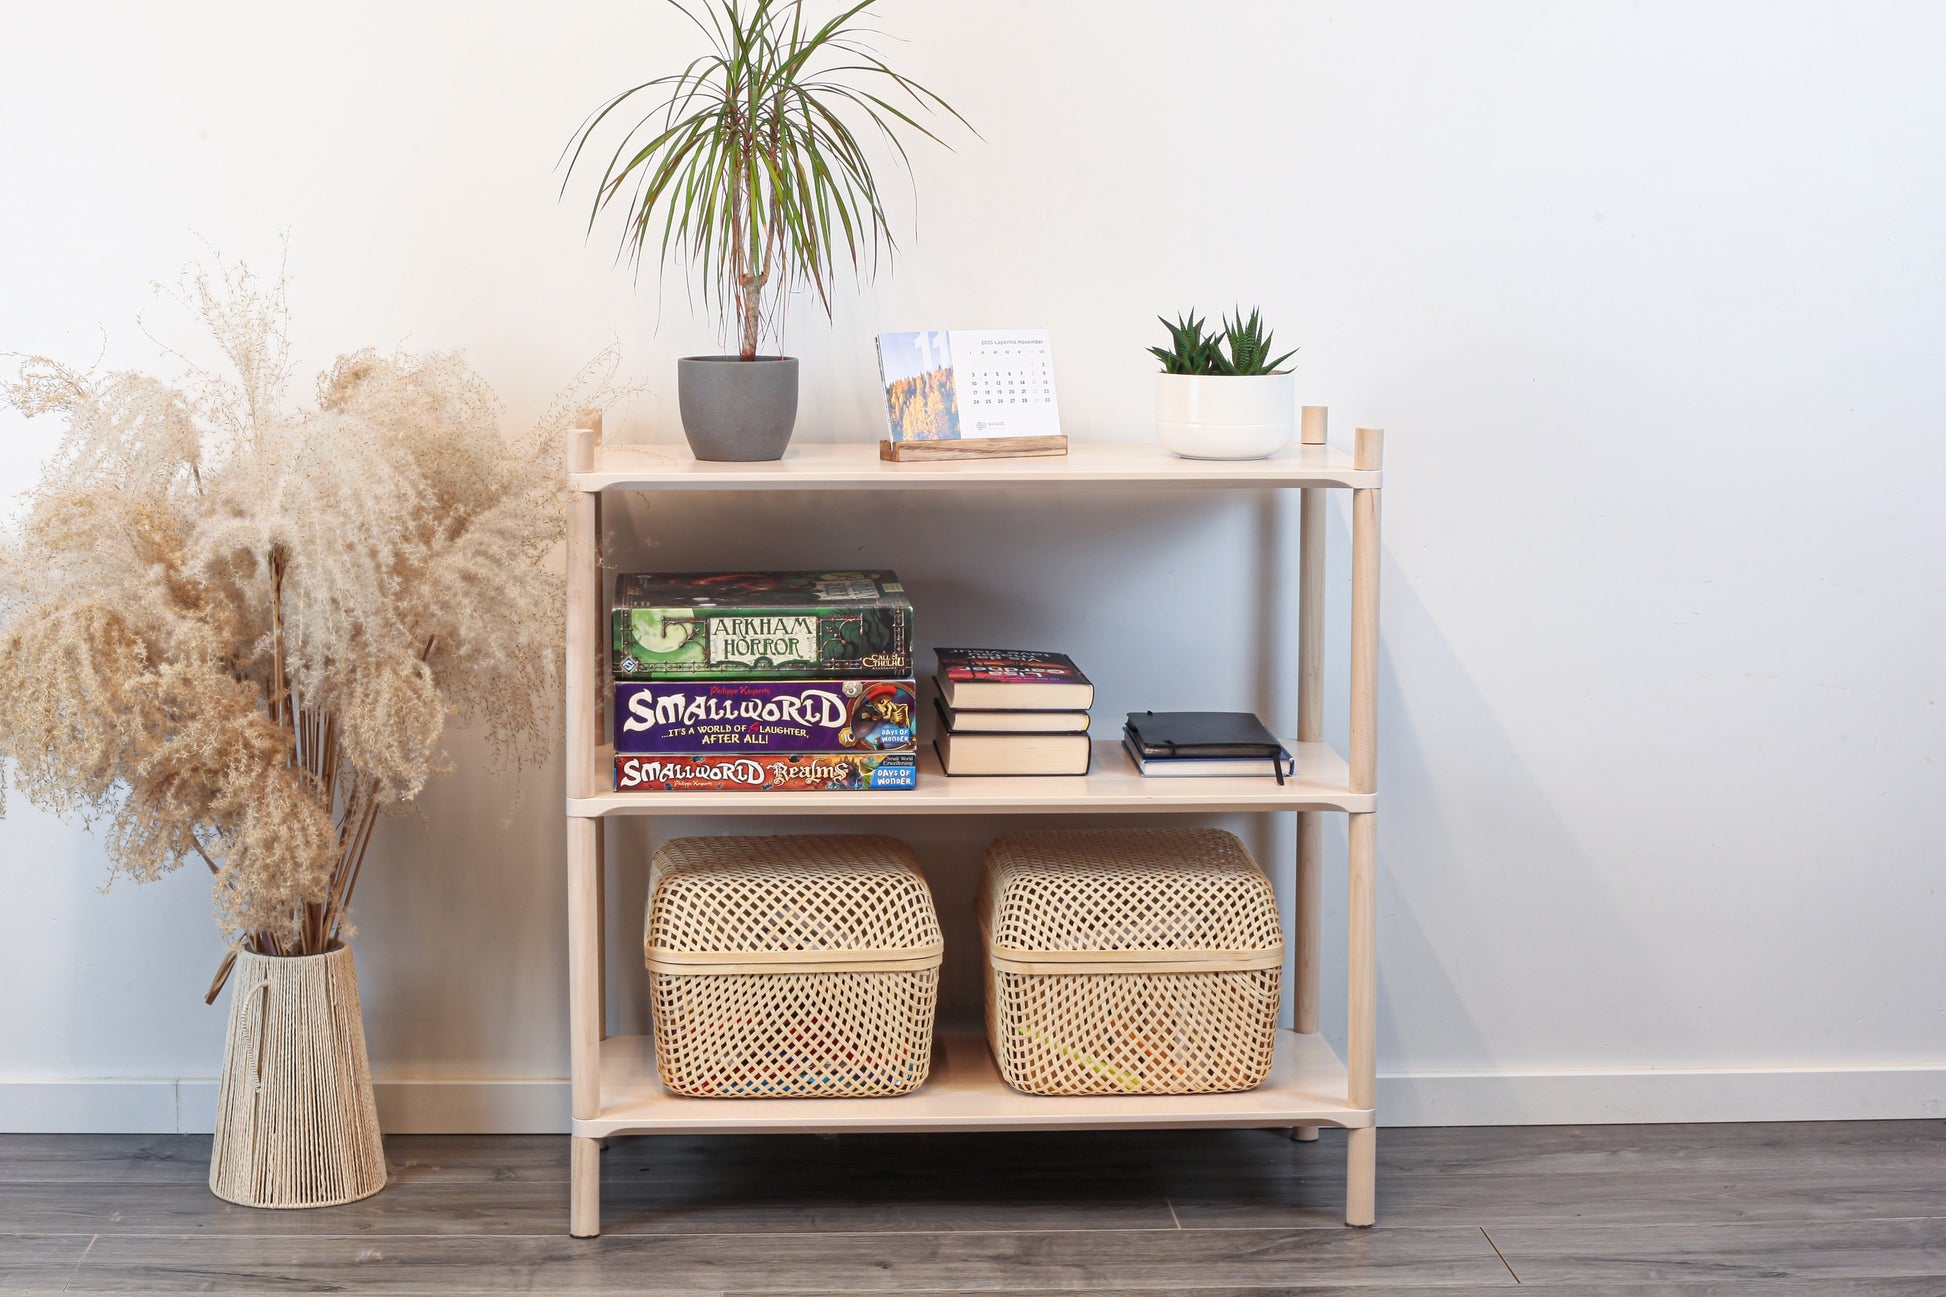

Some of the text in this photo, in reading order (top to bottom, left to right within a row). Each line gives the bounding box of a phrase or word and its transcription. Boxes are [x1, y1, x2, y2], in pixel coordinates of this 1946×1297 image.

[914, 331, 952, 371] 11
[712, 618, 813, 638] ARKHAM
[724, 638, 803, 659] HORROR
[862, 657, 905, 667] CTHULHU
[960, 666, 1065, 675] Gardner
[710, 686, 738, 695] Philippe
[688, 726, 695, 735] A
[697, 725, 732, 734] WORLD
[734, 725, 747, 733] OF
[702, 734, 769, 745] AFTER ALL!
[766, 758, 849, 786] Realms
